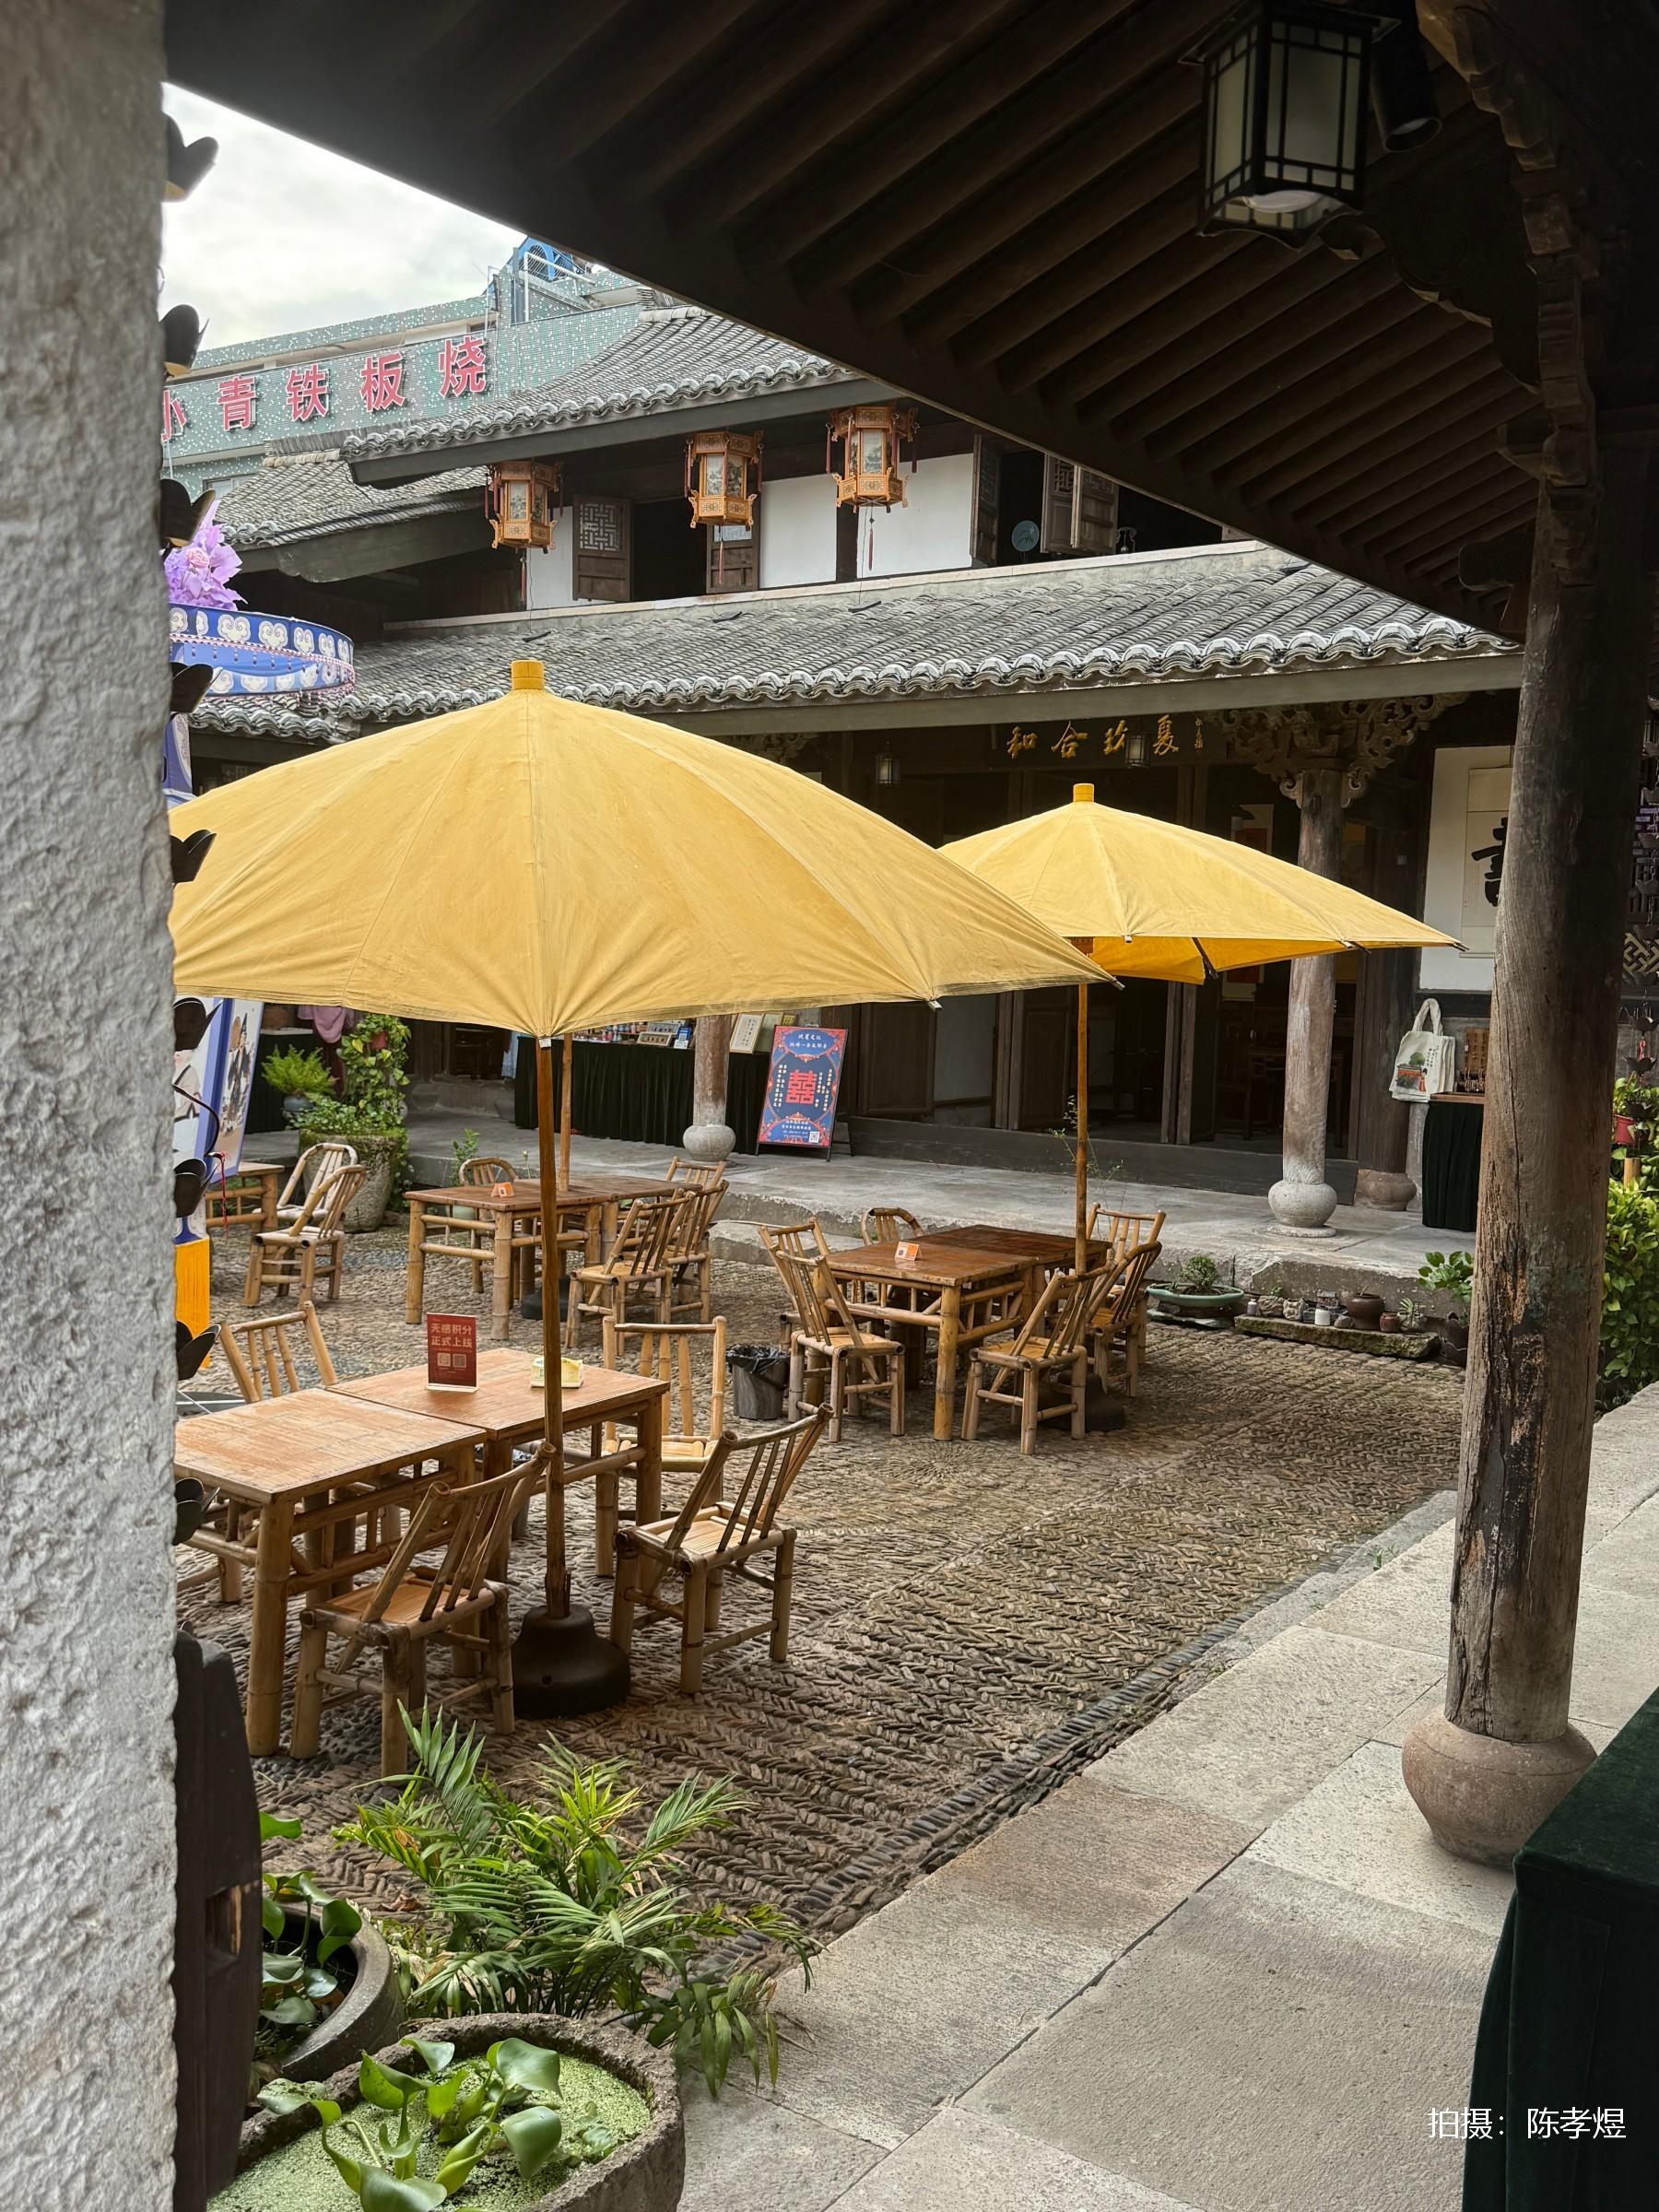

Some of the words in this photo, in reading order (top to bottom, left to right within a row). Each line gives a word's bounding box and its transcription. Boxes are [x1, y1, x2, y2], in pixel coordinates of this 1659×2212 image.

[430, 1322, 472, 1335] 无感积分
[431, 1335, 473, 1348] 正式上线
